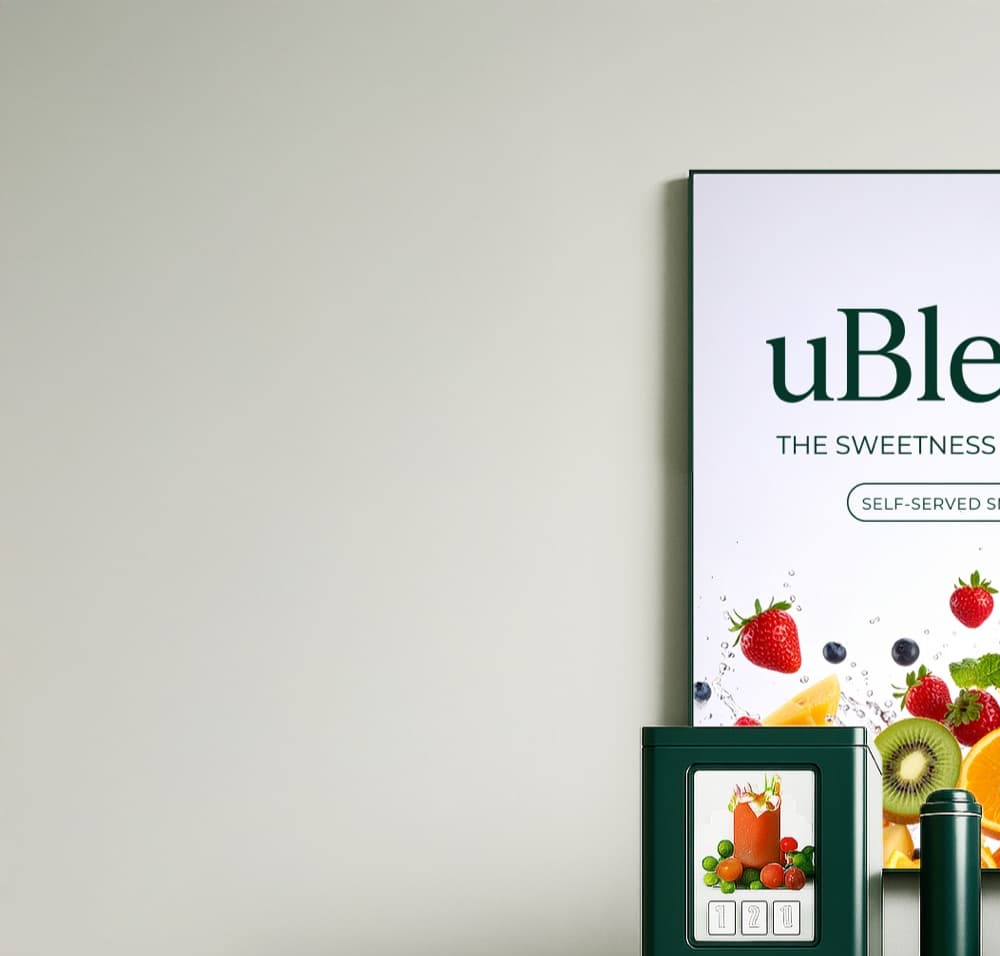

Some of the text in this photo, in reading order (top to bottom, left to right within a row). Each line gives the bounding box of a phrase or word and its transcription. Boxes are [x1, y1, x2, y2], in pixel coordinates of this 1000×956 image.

[775, 434, 828, 456] THE
[835, 434, 997, 456] SWEETNESS
[862, 496, 981, 513] SELF-SERVED
